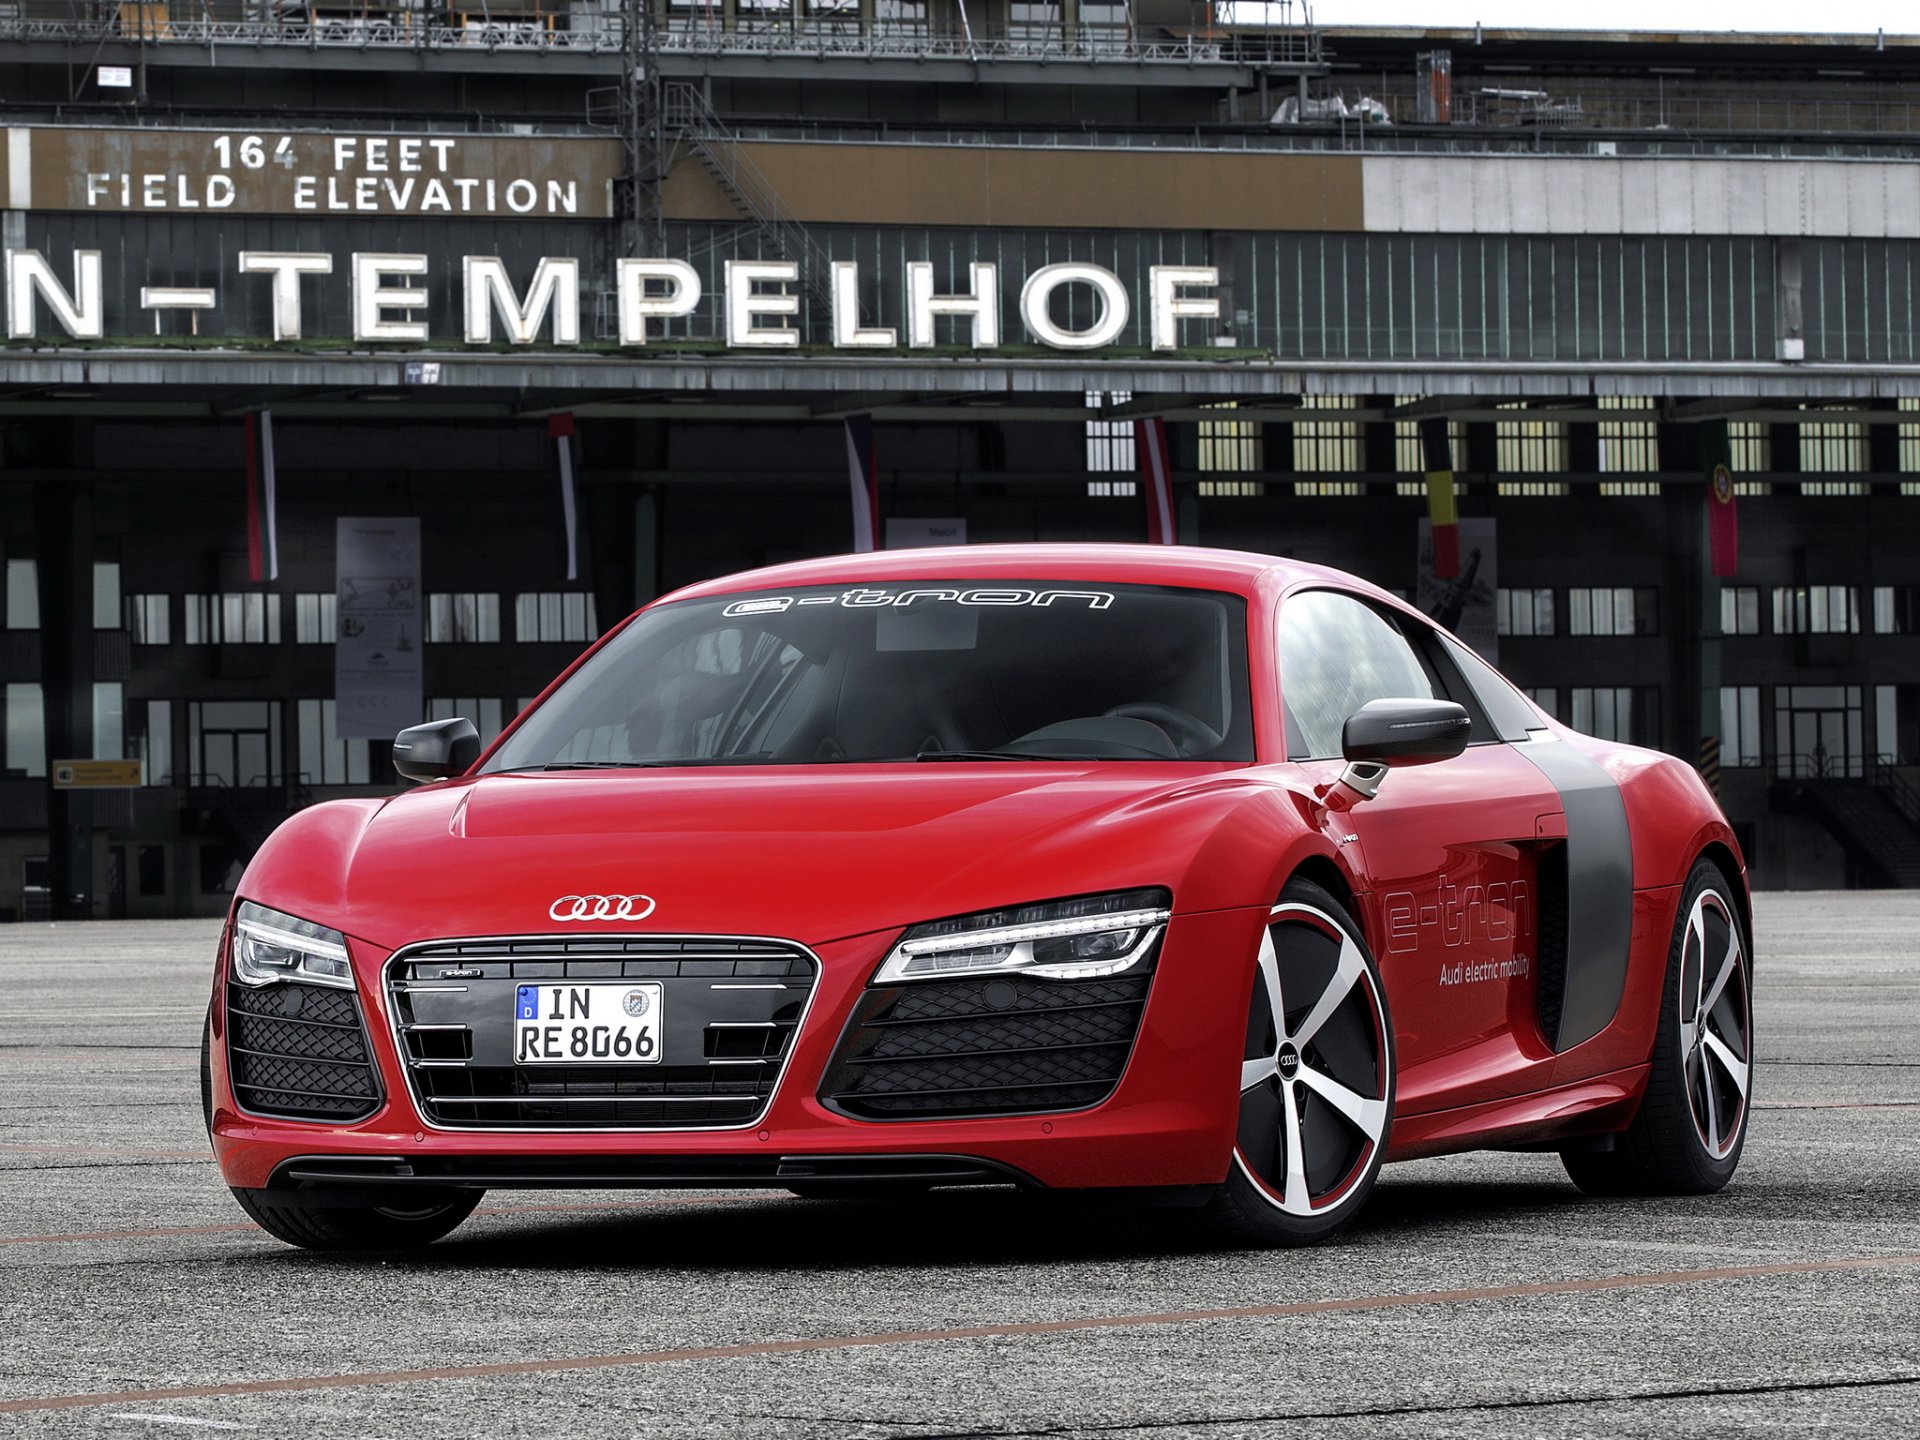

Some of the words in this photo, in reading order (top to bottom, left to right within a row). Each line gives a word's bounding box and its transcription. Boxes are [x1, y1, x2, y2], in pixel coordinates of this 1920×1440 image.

[214, 135, 298, 169] 164
[335, 139, 455, 171] FEET
[87, 173, 236, 208] FIELD
[294, 177, 578, 213] ELEVATION
[722, 589, 1115, 616] e-tron
[1384, 875, 1530, 953] e-tron
[1439, 963, 1463, 986] Audi
[1465, 957, 1498, 983] electric
[1499, 953, 1530, 979] mobility
[524, 1007, 533, 1018] D
[549, 988, 590, 1019] IN
[521, 1026, 563, 1057] RE
[570, 1026, 653, 1057] 8066
